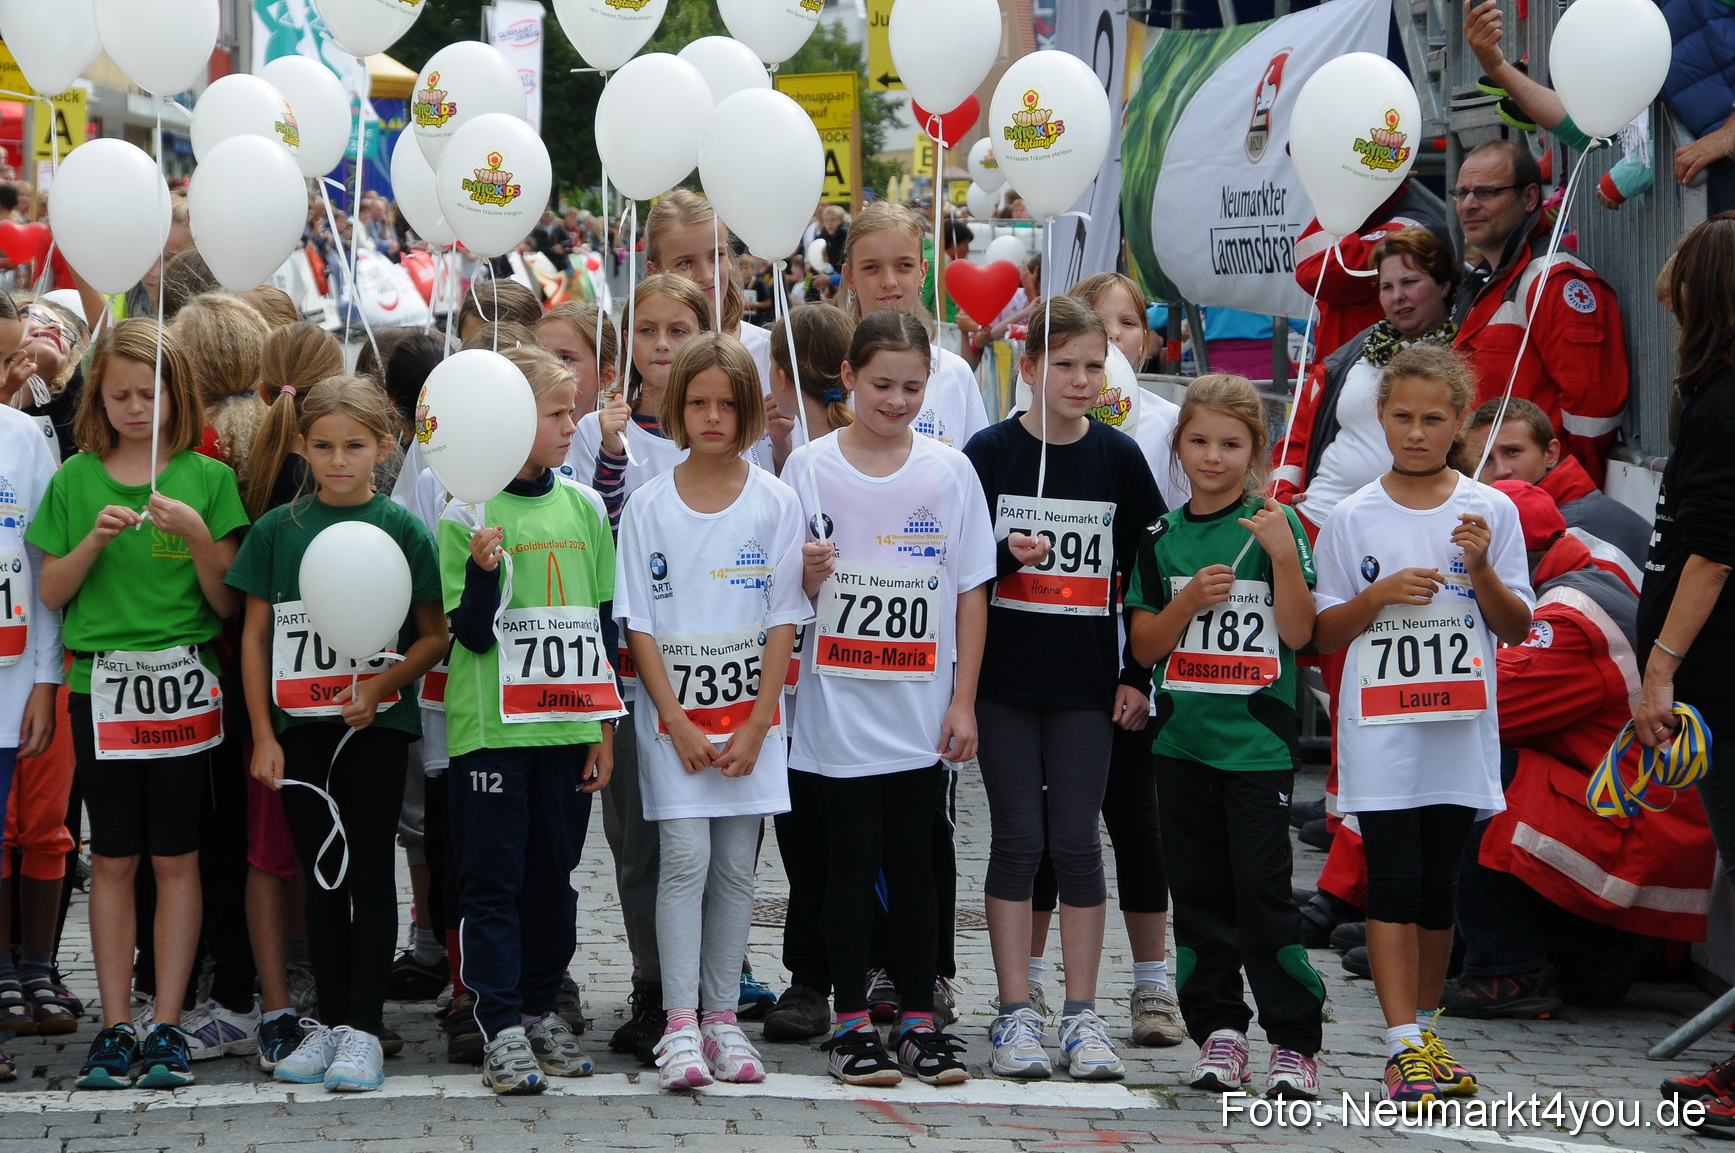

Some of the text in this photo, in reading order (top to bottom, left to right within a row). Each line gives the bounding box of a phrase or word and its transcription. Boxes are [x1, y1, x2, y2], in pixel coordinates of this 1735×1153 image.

[44, 108, 73, 146] A
[1219, 180, 1287, 219] Neumarkter
[1044, 511, 1098, 525] Neumarkt
[516, 539, 568, 553] Goldhutlauf
[569, 540, 586, 550] 2012
[876, 535, 896, 545] 14.
[710, 569, 727, 580] 14.
[869, 576, 924, 589] Neumarkt
[652, 582, 673, 593] ARTL
[1225, 593, 1259, 603] markt
[836, 593, 928, 639] 7280
[1402, 616, 1461, 629] Neumarkt
[503, 618, 593, 633] PARTL Neumarkt
[662, 638, 754, 656] PARTL Neumarkt
[828, 643, 926, 666] Anna-Maria
[1371, 633, 1471, 679] 7012
[514, 635, 600, 678] 7017
[96, 659, 133, 673] PARTL
[1178, 658, 1260, 680] Cassandra
[673, 656, 762, 706] 7335
[105, 669, 209, 715] 7002
[537, 690, 594, 708] Janika
[1399, 691, 1450, 709] Laura
[130, 725, 197, 745] Jasmin
[470, 771, 503, 793] 112
